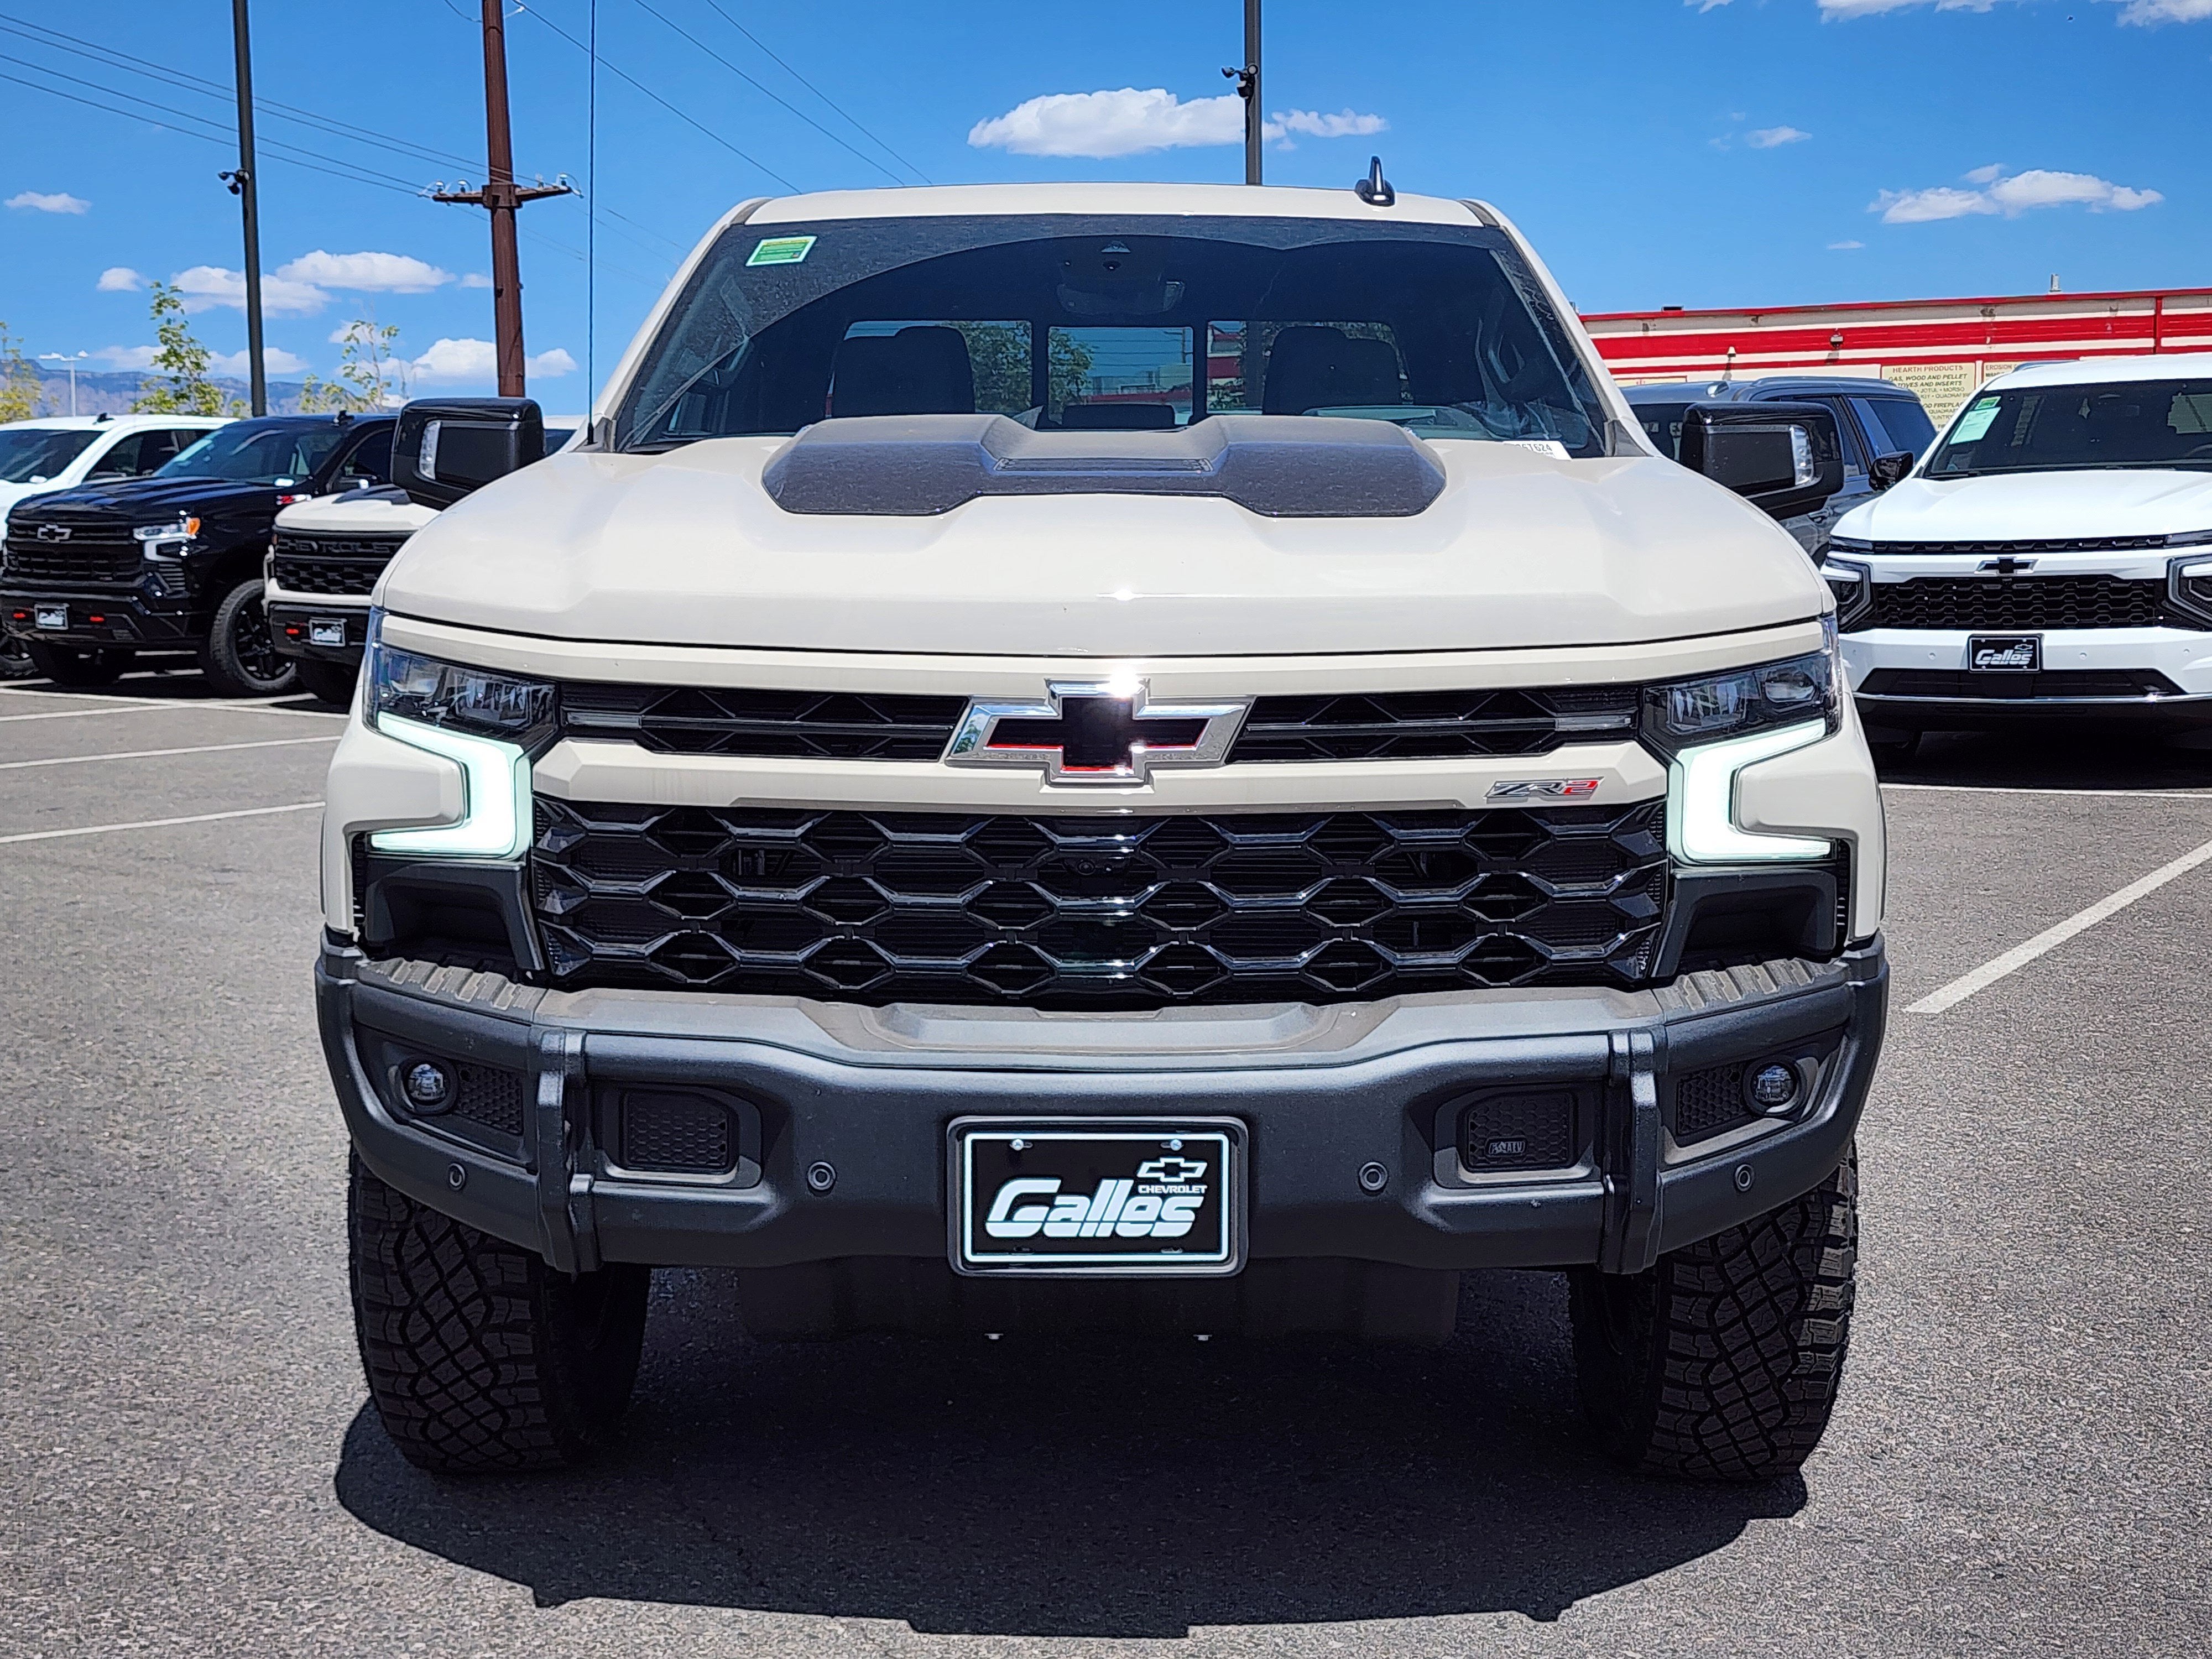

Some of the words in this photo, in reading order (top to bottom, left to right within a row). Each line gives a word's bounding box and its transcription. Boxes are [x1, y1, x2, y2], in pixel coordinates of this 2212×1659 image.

[1975, 649, 2032, 665] Galles
[1484, 777, 1604, 798] ZR2
[1138, 1185, 1207, 1194] CHEVROLET
[985, 1179, 1204, 1238] Galles
